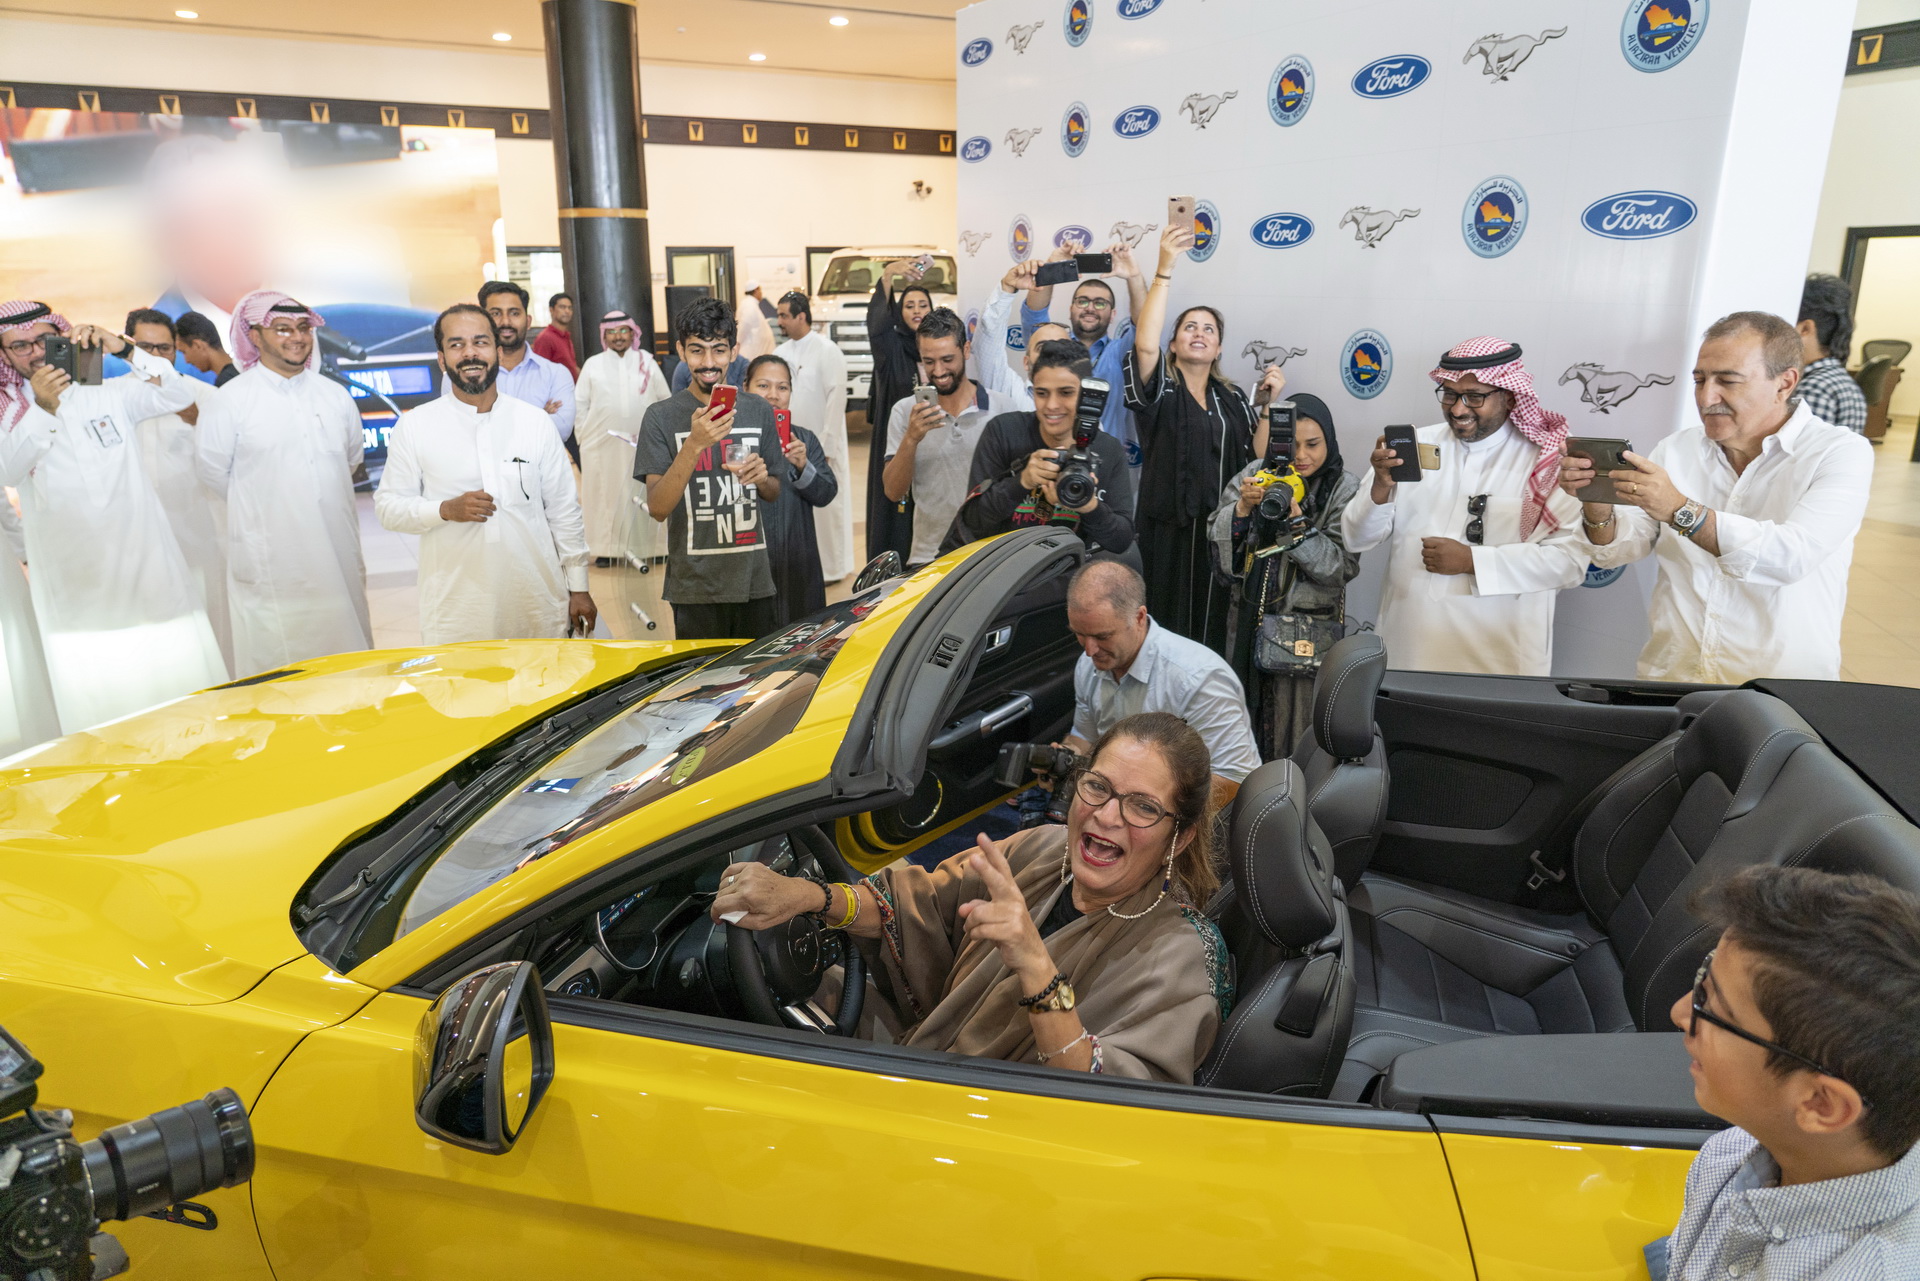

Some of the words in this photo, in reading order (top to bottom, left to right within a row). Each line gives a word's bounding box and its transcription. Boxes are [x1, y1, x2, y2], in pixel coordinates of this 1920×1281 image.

[1664, 22, 1700, 61] VEHICLES
[1365, 61, 1416, 93] Ford
[1121, 111, 1152, 134] Ford
[1261, 218, 1302, 242] Ford
[1601, 199, 1675, 231] Ford
[1495, 220, 1522, 250] VEHICLES
